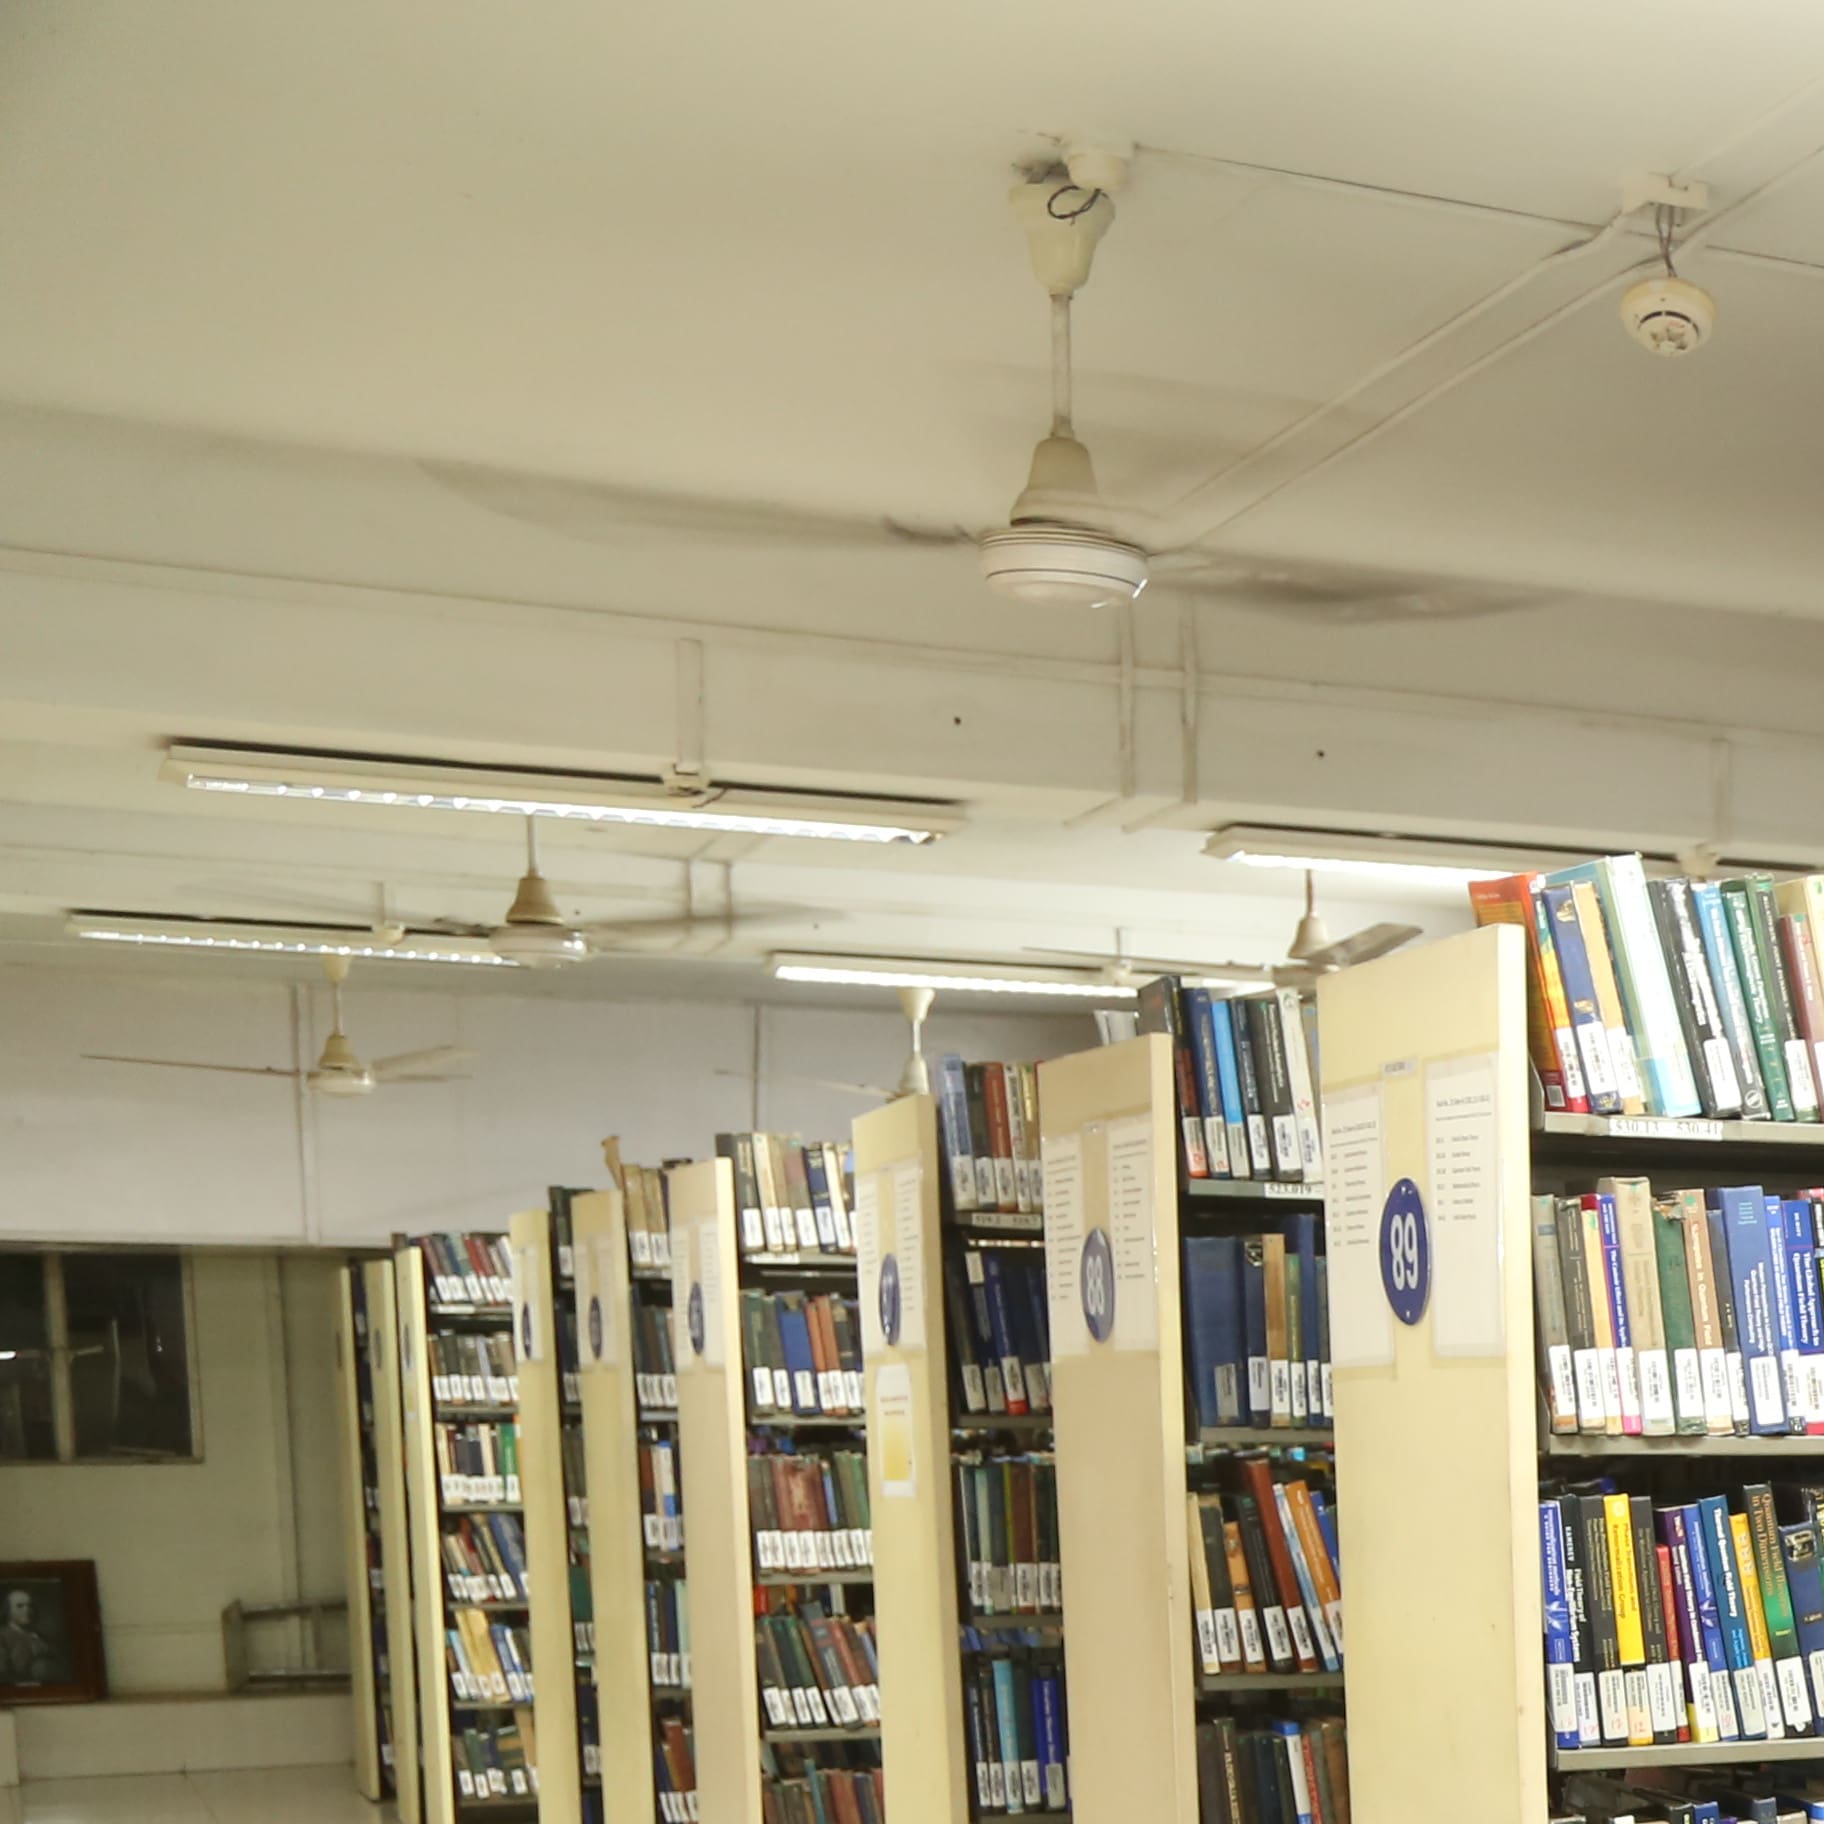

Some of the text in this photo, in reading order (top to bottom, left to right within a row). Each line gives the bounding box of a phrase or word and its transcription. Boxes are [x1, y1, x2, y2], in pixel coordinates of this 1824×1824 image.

[1615, 1121, 1659, 1133] 530.13
[1676, 1122, 1718, 1135] 530.41
[1087, 1255, 1105, 1315] 88
[1390, 1212, 1419, 1291] 89
[1762, 1494, 1783, 1571] Quantum Field
[1717, 1540, 1730, 1571] Quantum
[1726, 1593, 1738, 1617] Theory
